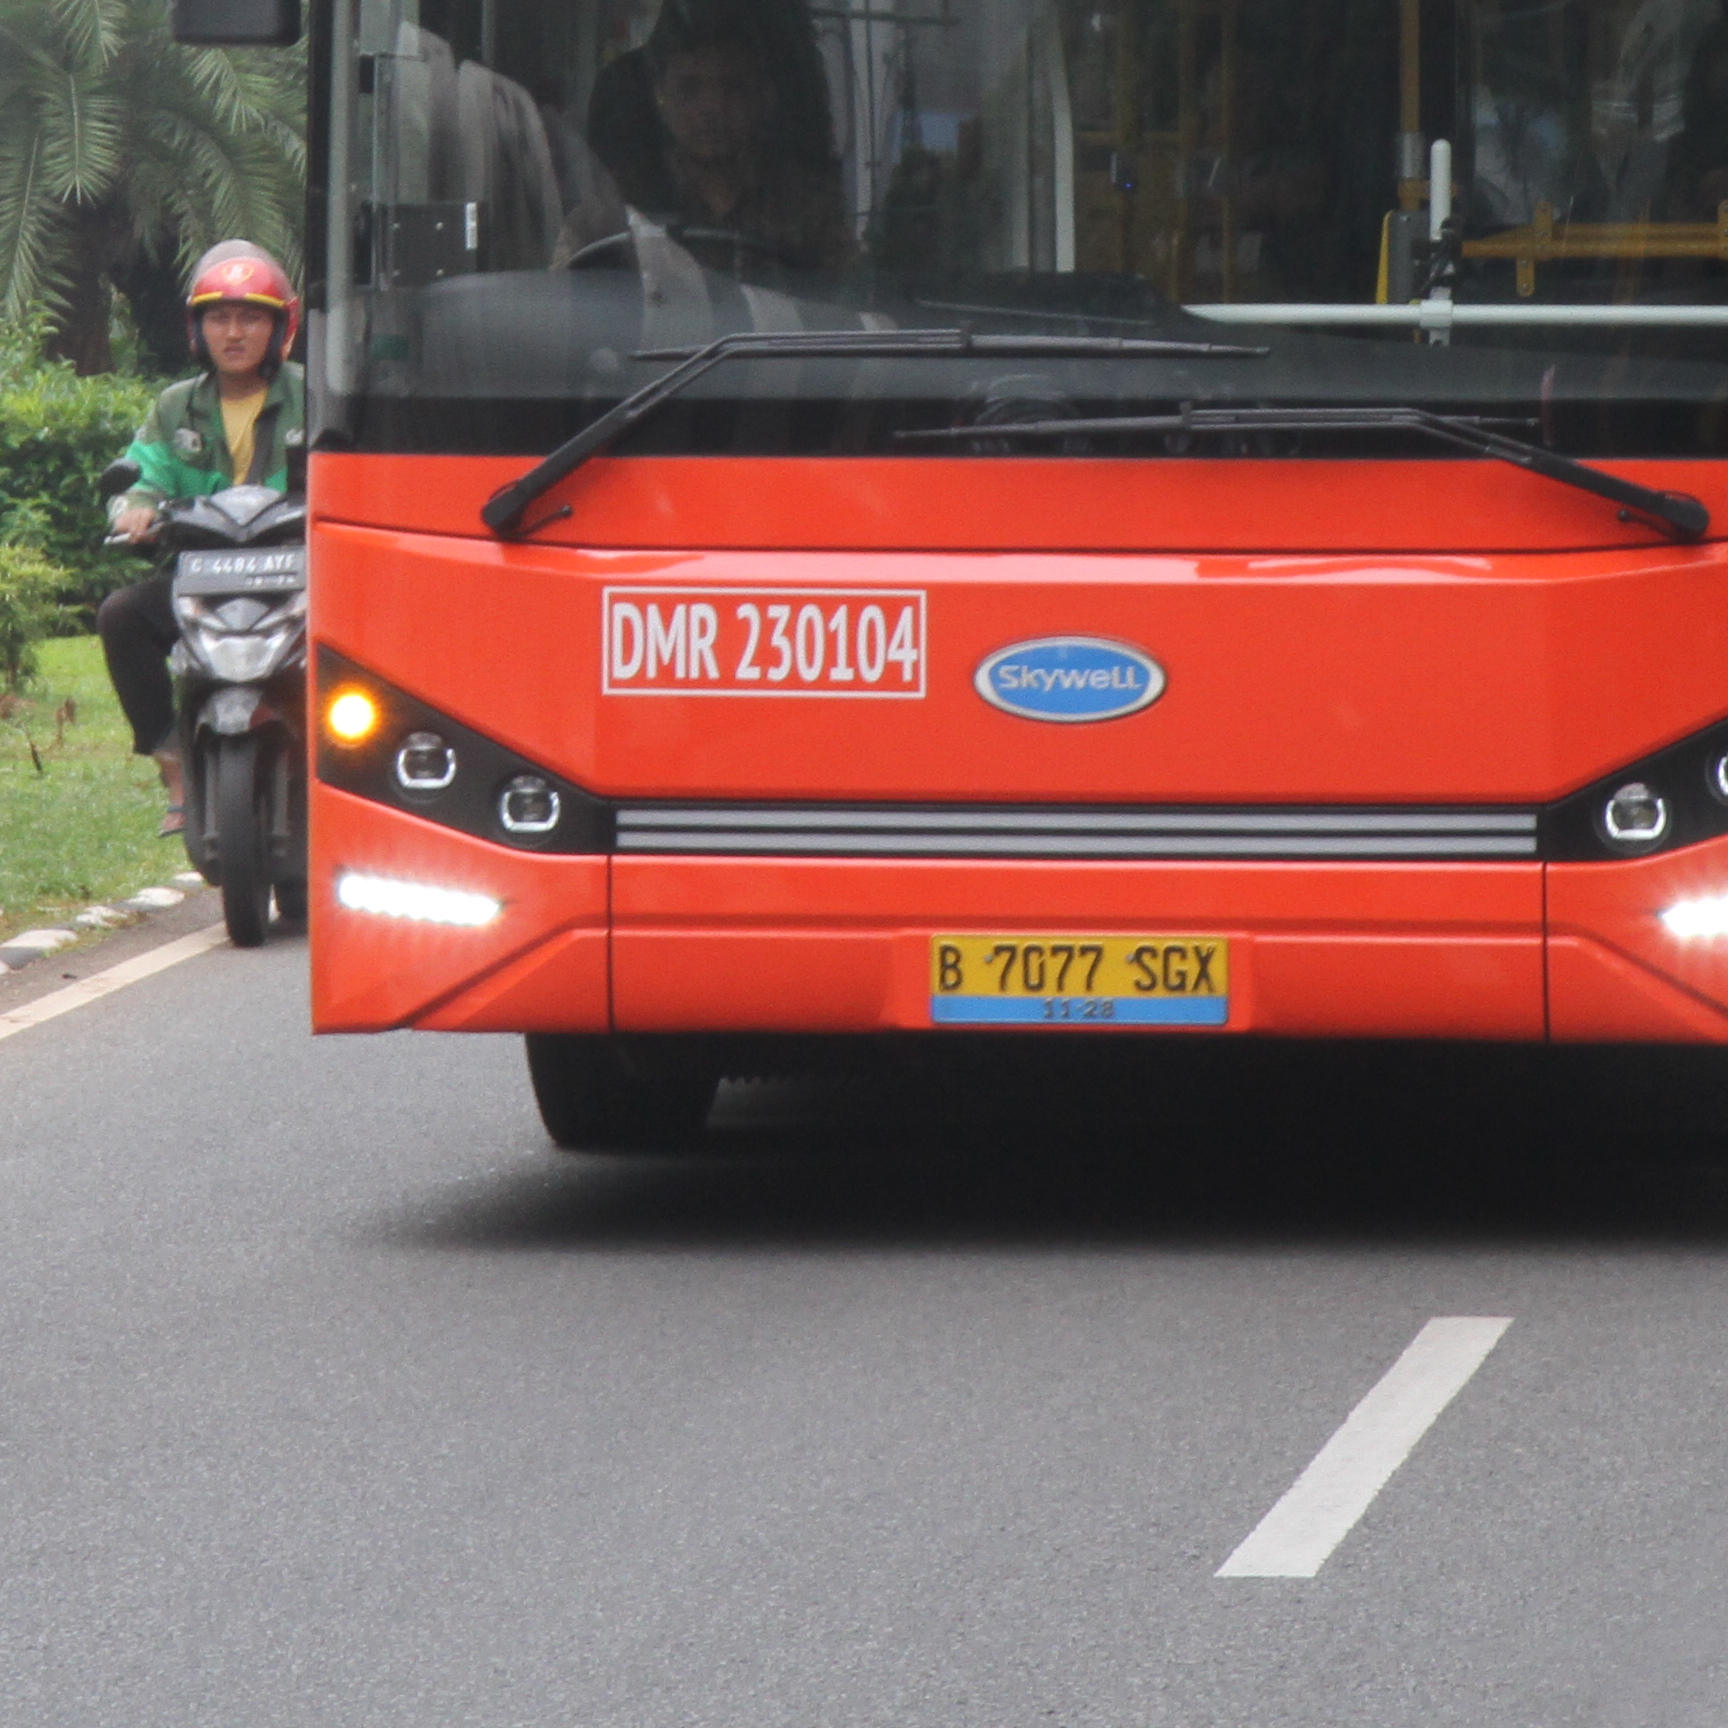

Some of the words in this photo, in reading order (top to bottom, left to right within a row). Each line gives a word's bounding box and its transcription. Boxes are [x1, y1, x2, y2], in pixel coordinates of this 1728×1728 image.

[612, 602, 720, 680] DMR
[735, 603, 919, 682] 230104
[939, 943, 963, 992] B
[993, 943, 1104, 993] 7077
[1133, 943, 1216, 993] SGX
